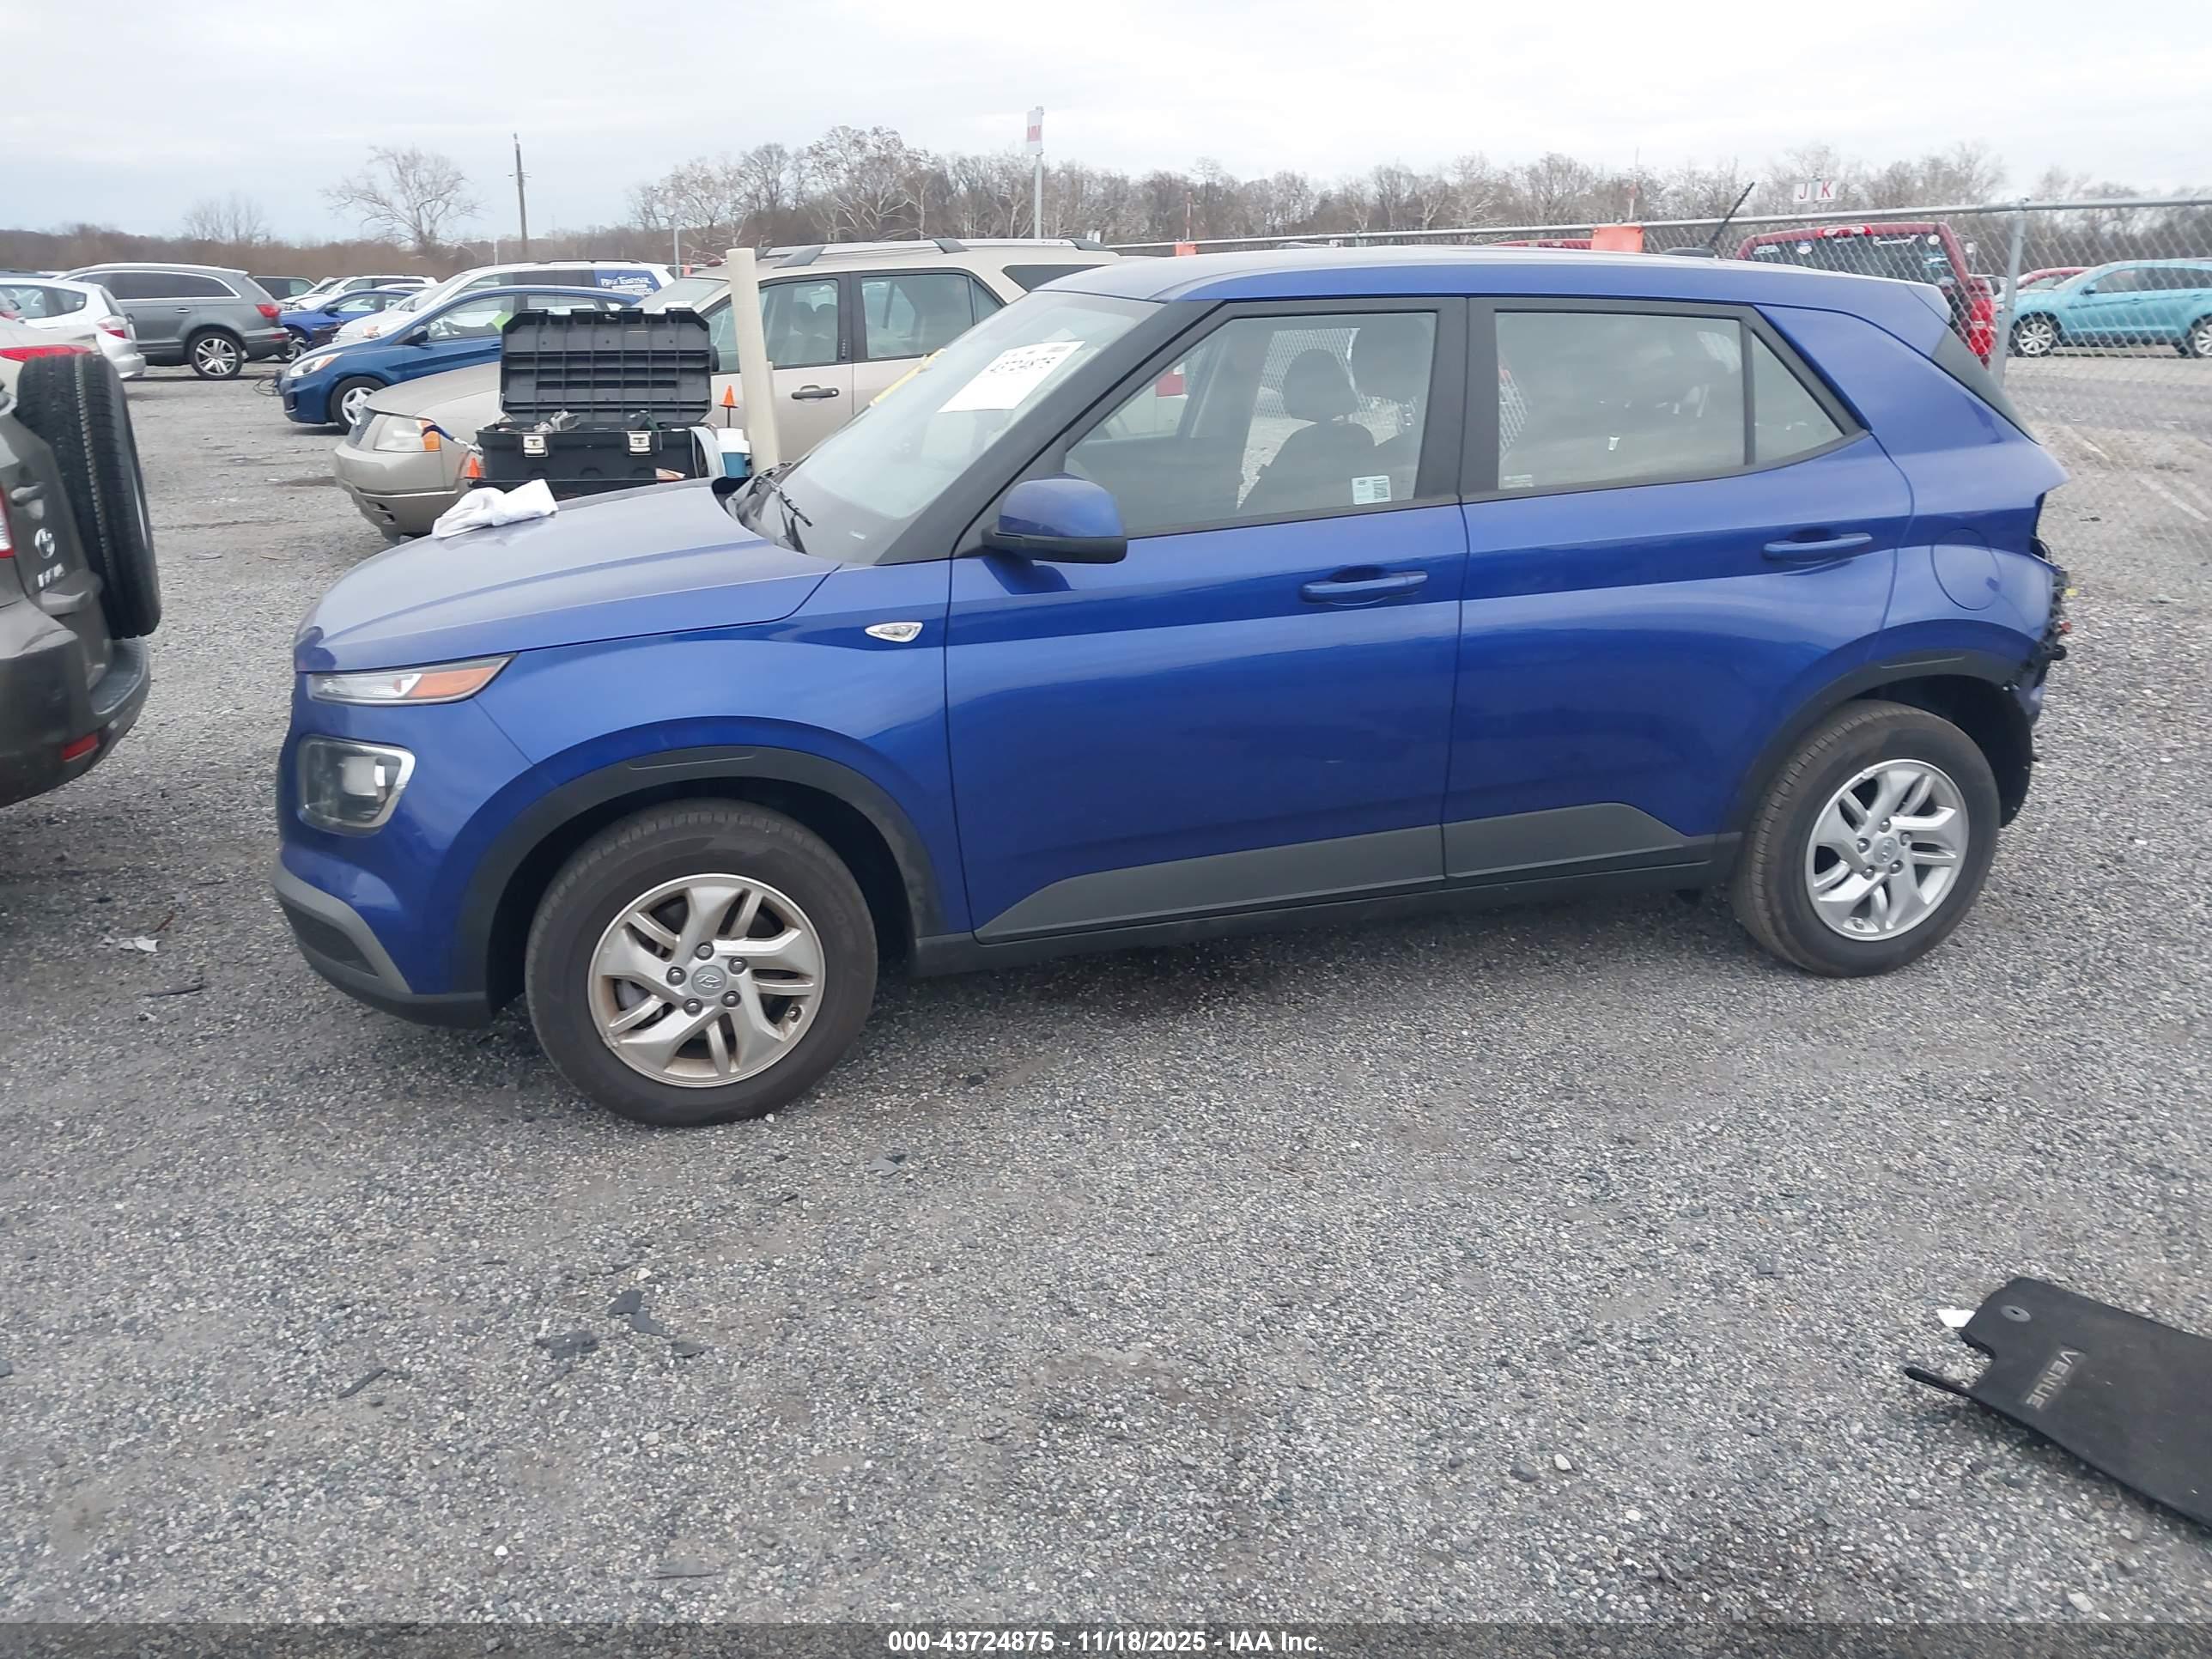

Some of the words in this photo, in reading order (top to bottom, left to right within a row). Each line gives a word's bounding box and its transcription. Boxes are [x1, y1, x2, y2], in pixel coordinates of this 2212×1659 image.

[1798, 181, 1808, 199] J
[1821, 180, 1832, 198] K
[2026, 1351, 2079, 1409] VENUE
